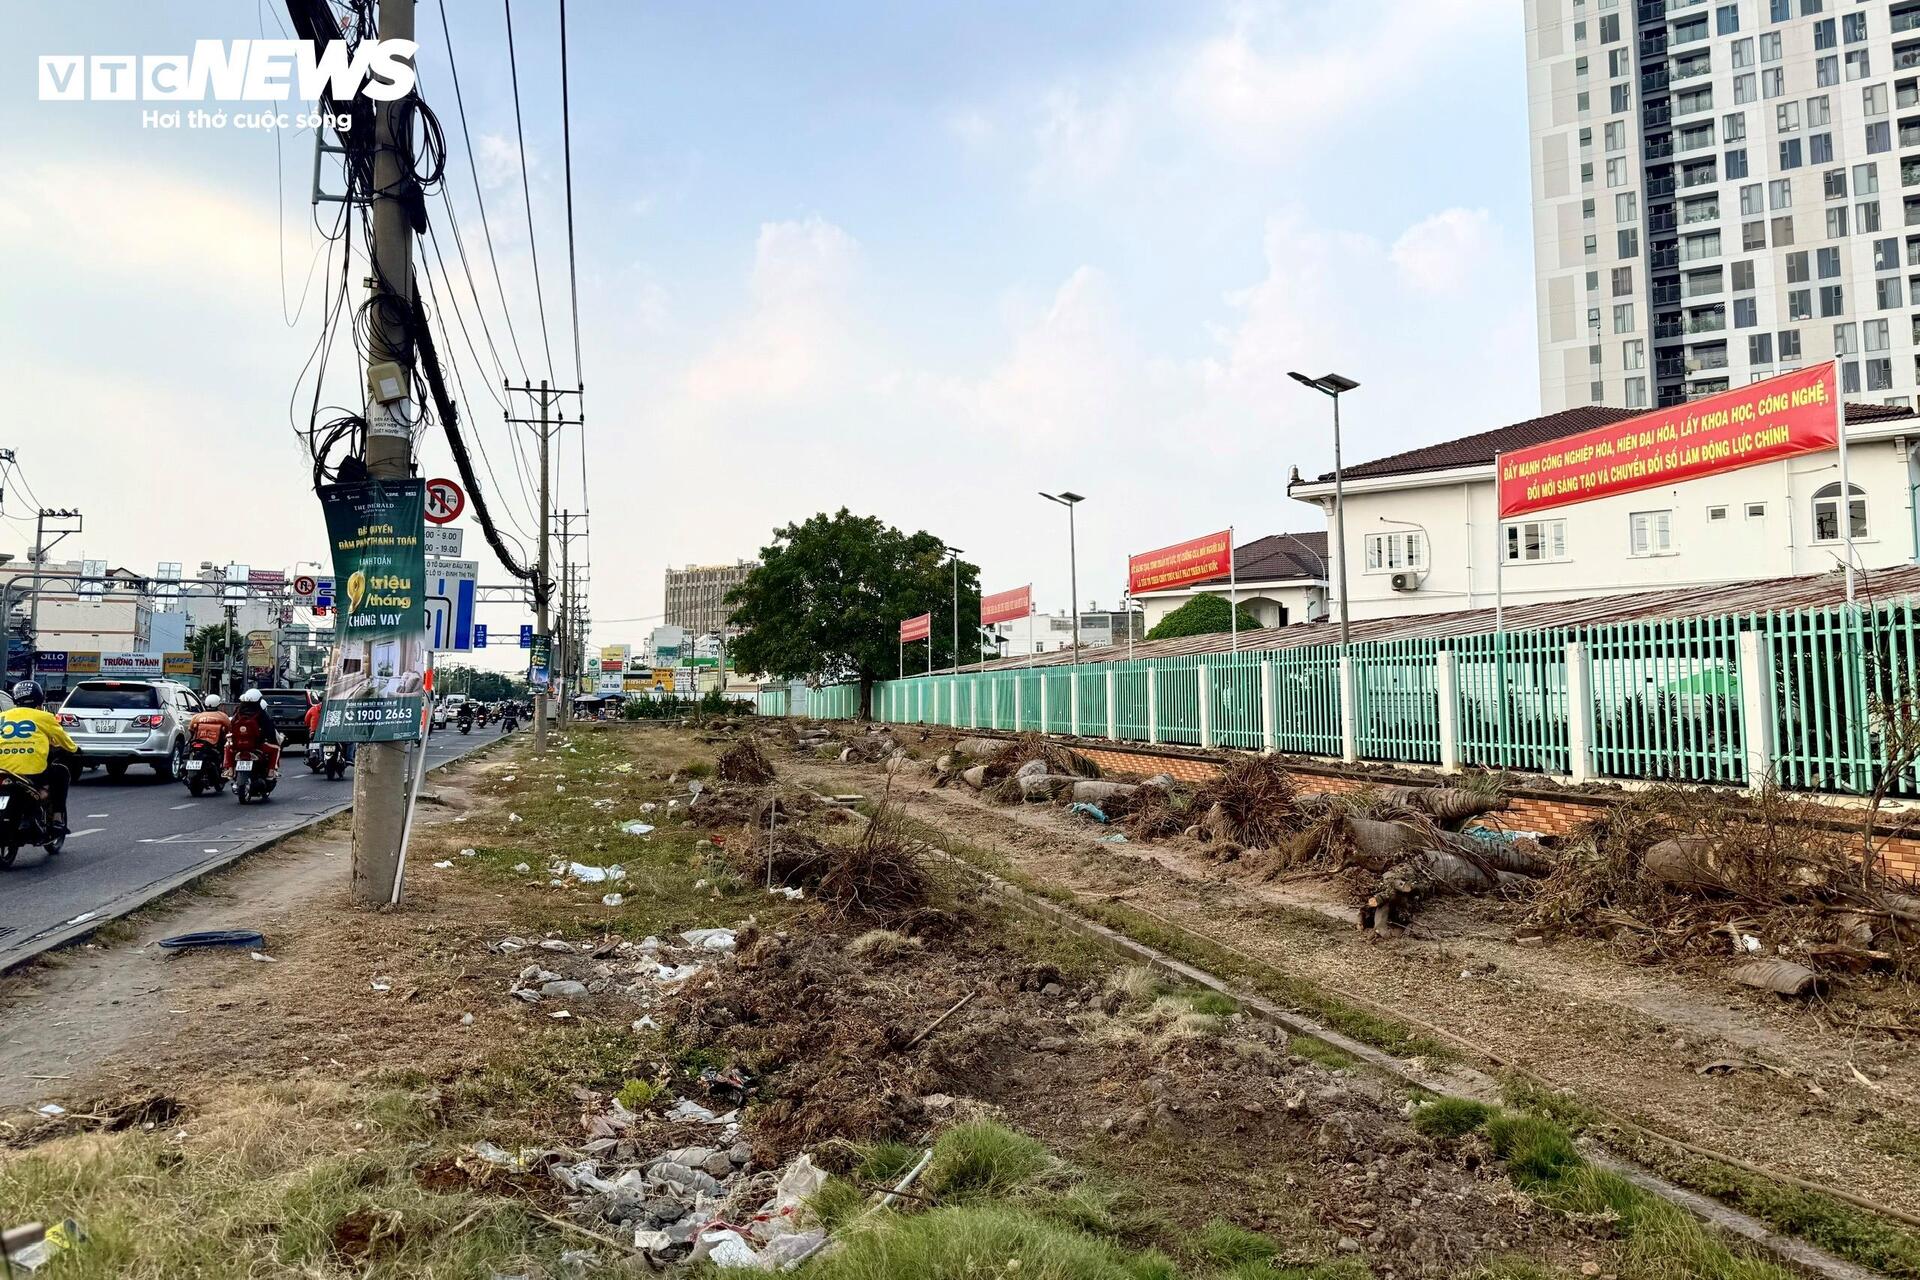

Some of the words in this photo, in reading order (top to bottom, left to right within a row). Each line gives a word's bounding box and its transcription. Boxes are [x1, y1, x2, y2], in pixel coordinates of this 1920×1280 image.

[1504, 460, 1517, 481] ĐẨY
[1519, 462, 1540, 480] MẠNH
[1542, 454, 1563, 472] CÔNG
[1564, 444, 1594, 465] NGHIỆP
[1596, 438, 1615, 457] HÓA,
[1617, 432, 1637, 455] HIỆN
[1640, 430, 1654, 449] ĐẠI
[1656, 419, 1678, 443] HÓA,
[1681, 412, 1699, 437] LẤY
[1702, 410, 1729, 432] KHOA
[1732, 402, 1756, 426] HỌC,
[1758, 393, 1789, 416] CÔNG
[1792, 380, 1829, 408] NGHỆ,
[1527, 478, 1540, 500] ĐỔI
[1542, 478, 1556, 497] MỚI
[1558, 473, 1578, 493] SÁNG
[1580, 473, 1596, 492] TẠO
[1598, 464, 1610, 485] VÀ
[1611, 454, 1646, 482] CHUYỂN
[1648, 449, 1664, 474] ĐỔI
[1666, 446, 1678, 470] SỐ
[1680, 444, 1700, 467] LÀM
[1702, 440, 1730, 464] ĐỘNG
[1732, 432, 1752, 458] LỰC
[1754, 424, 1790, 448] CHÍNH
[396, 536, 417, 545] TOÁN
[370, 575, 411, 593] triệu
[365, 593, 411, 609] /tháng
[380, 614, 401, 626] VAY
[136, 657, 159, 667] THÀNH
[357, 709, 382, 720] 1900
[385, 708, 412, 720] 2663
